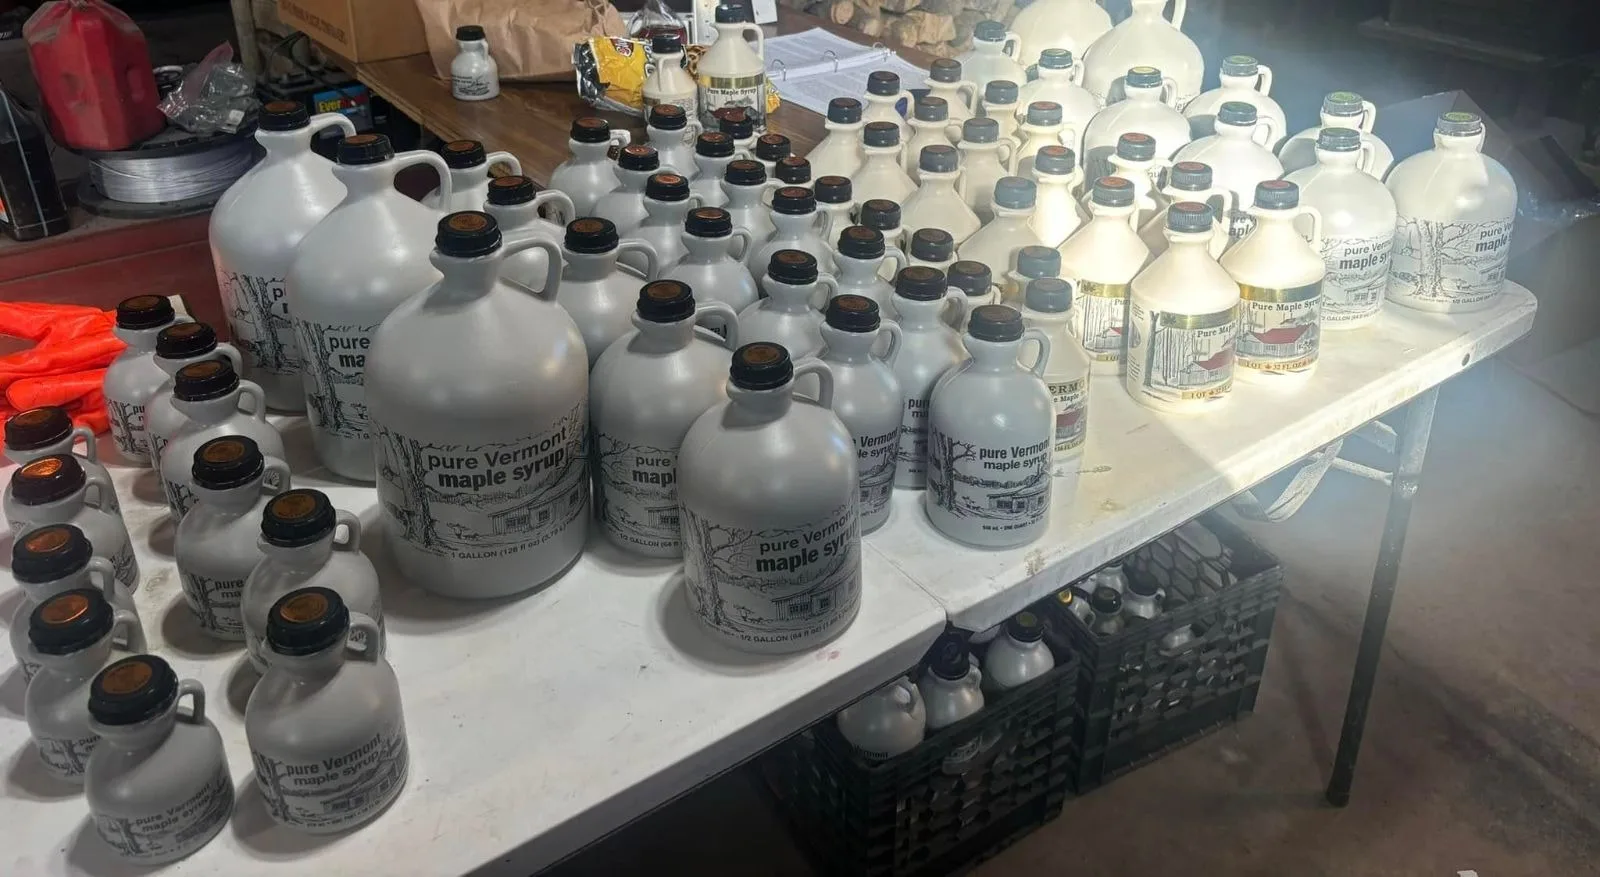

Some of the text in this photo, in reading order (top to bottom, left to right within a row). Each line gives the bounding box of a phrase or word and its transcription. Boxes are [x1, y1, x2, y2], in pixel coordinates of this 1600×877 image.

[1480, 227, 1502, 240] pure
[1344, 246, 1370, 257] pure
[1339, 253, 1378, 270] maple
[1252, 302, 1273, 311] Pure
[1276, 302, 1302, 312] Maple
[1197, 329, 1217, 338] Pure
[329, 336, 371, 352] pure
[133, 405, 145, 415] pu
[428, 426, 567, 471] pure Vermont
[980, 448, 1008, 460] pure
[1011, 436, 1050, 458] Vermont
[438, 447, 564, 491] maple syrup
[636, 456, 671, 467] pure
[984, 452, 1047, 472] maple syrup
[632, 467, 677, 488] mapl
[760, 505, 854, 555] pure Vermont
[630, 536, 660, 547] GALLON
[458, 551, 497, 559] GALLON
[756, 548, 819, 573] maple
[754, 634, 788, 643] GALLON
[287, 733, 380, 777] pure Vermont
[294, 751, 379, 785] maple syrup
[136, 814, 162, 827] pure
[142, 816, 179, 832] maple
